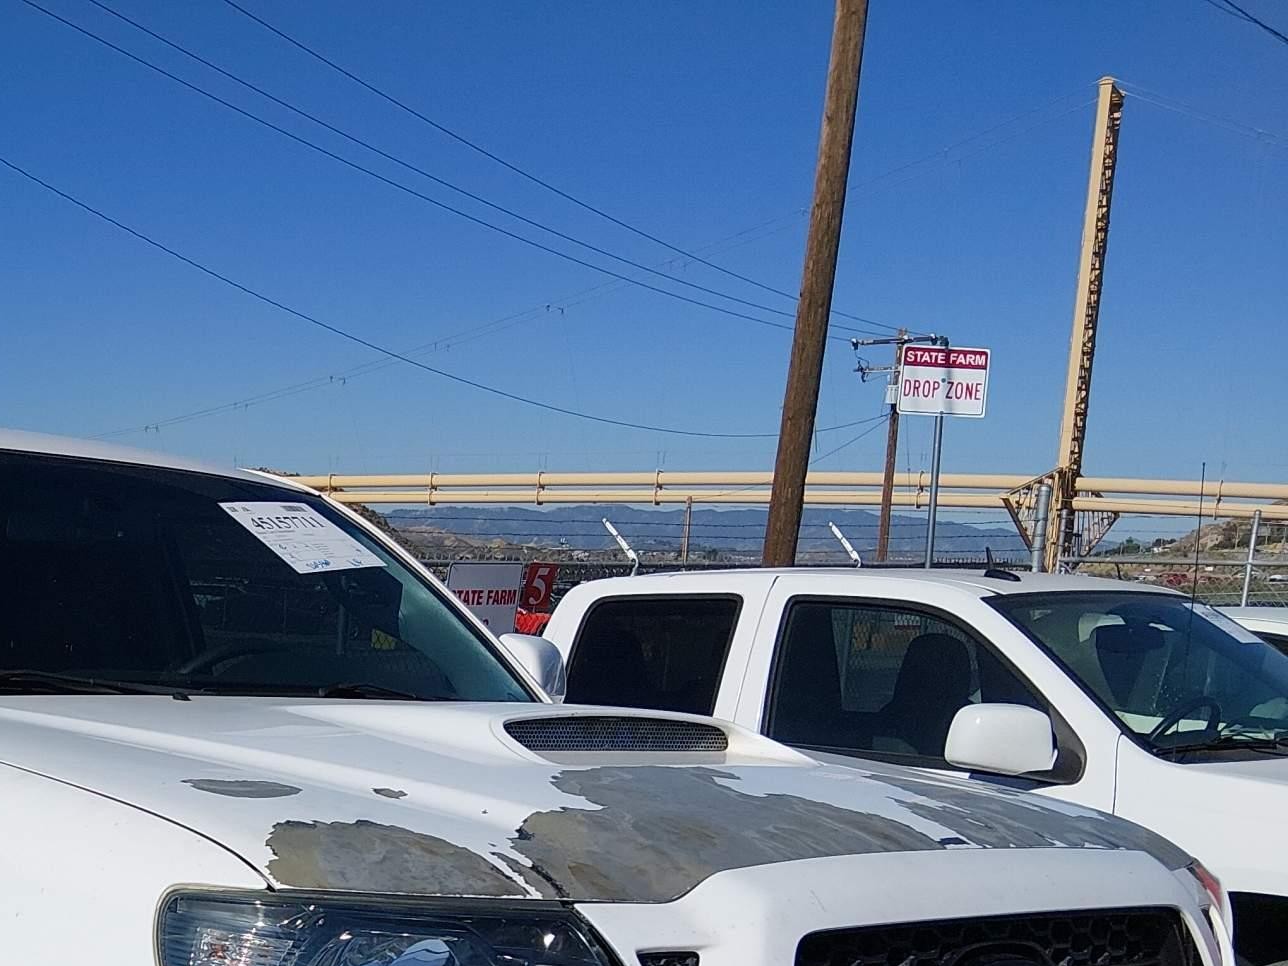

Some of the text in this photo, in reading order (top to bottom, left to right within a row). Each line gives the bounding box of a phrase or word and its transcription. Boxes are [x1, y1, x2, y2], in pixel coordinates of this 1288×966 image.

[906, 350, 986, 366] STATE FARM
[903, 378, 983, 401] DROP ZONE
[250, 516, 326, 530] 45157711
[528, 567, 550, 605] 5
[486, 590, 517, 605] FARM
